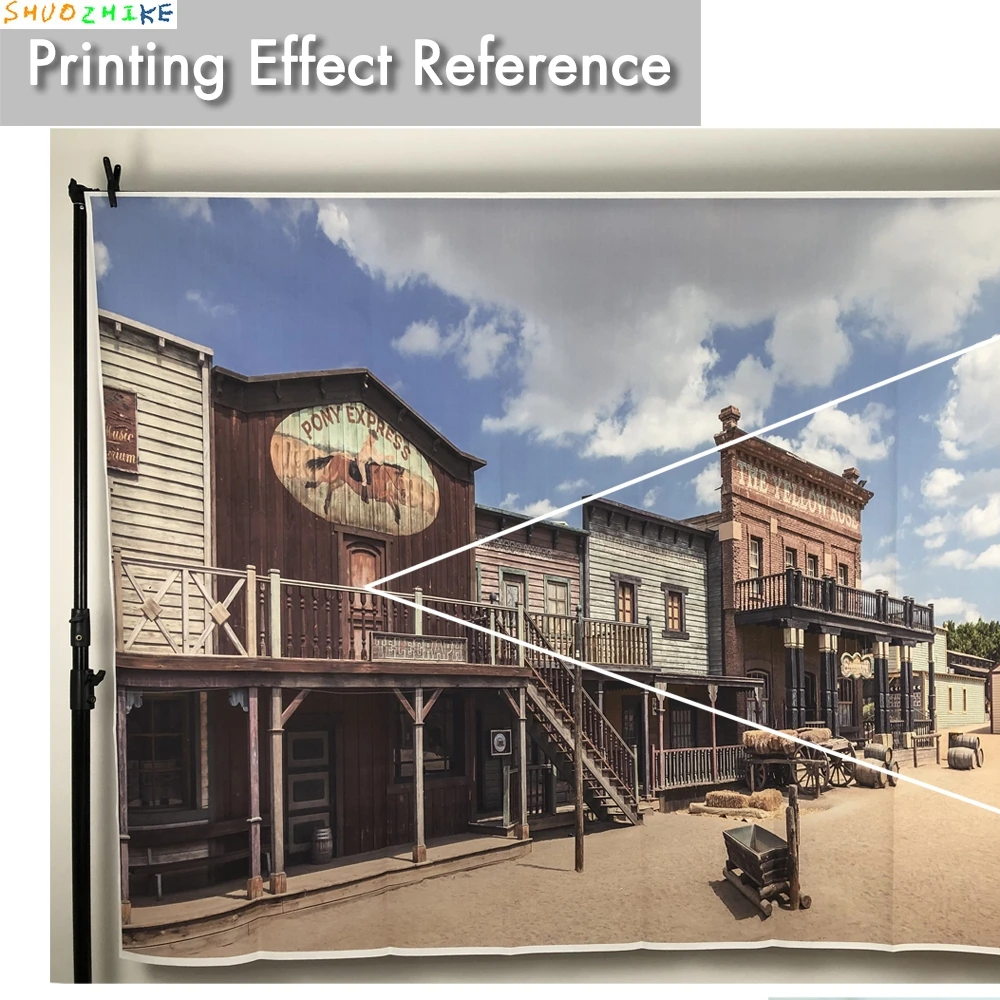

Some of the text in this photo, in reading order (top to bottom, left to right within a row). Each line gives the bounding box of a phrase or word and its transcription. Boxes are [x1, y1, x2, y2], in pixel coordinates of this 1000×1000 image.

[301, 405, 411, 461] PONY EXPRESS
[736, 460, 859, 530] THE YELLOW ROSE
[375, 636, 463, 661] TELEGRAPH
